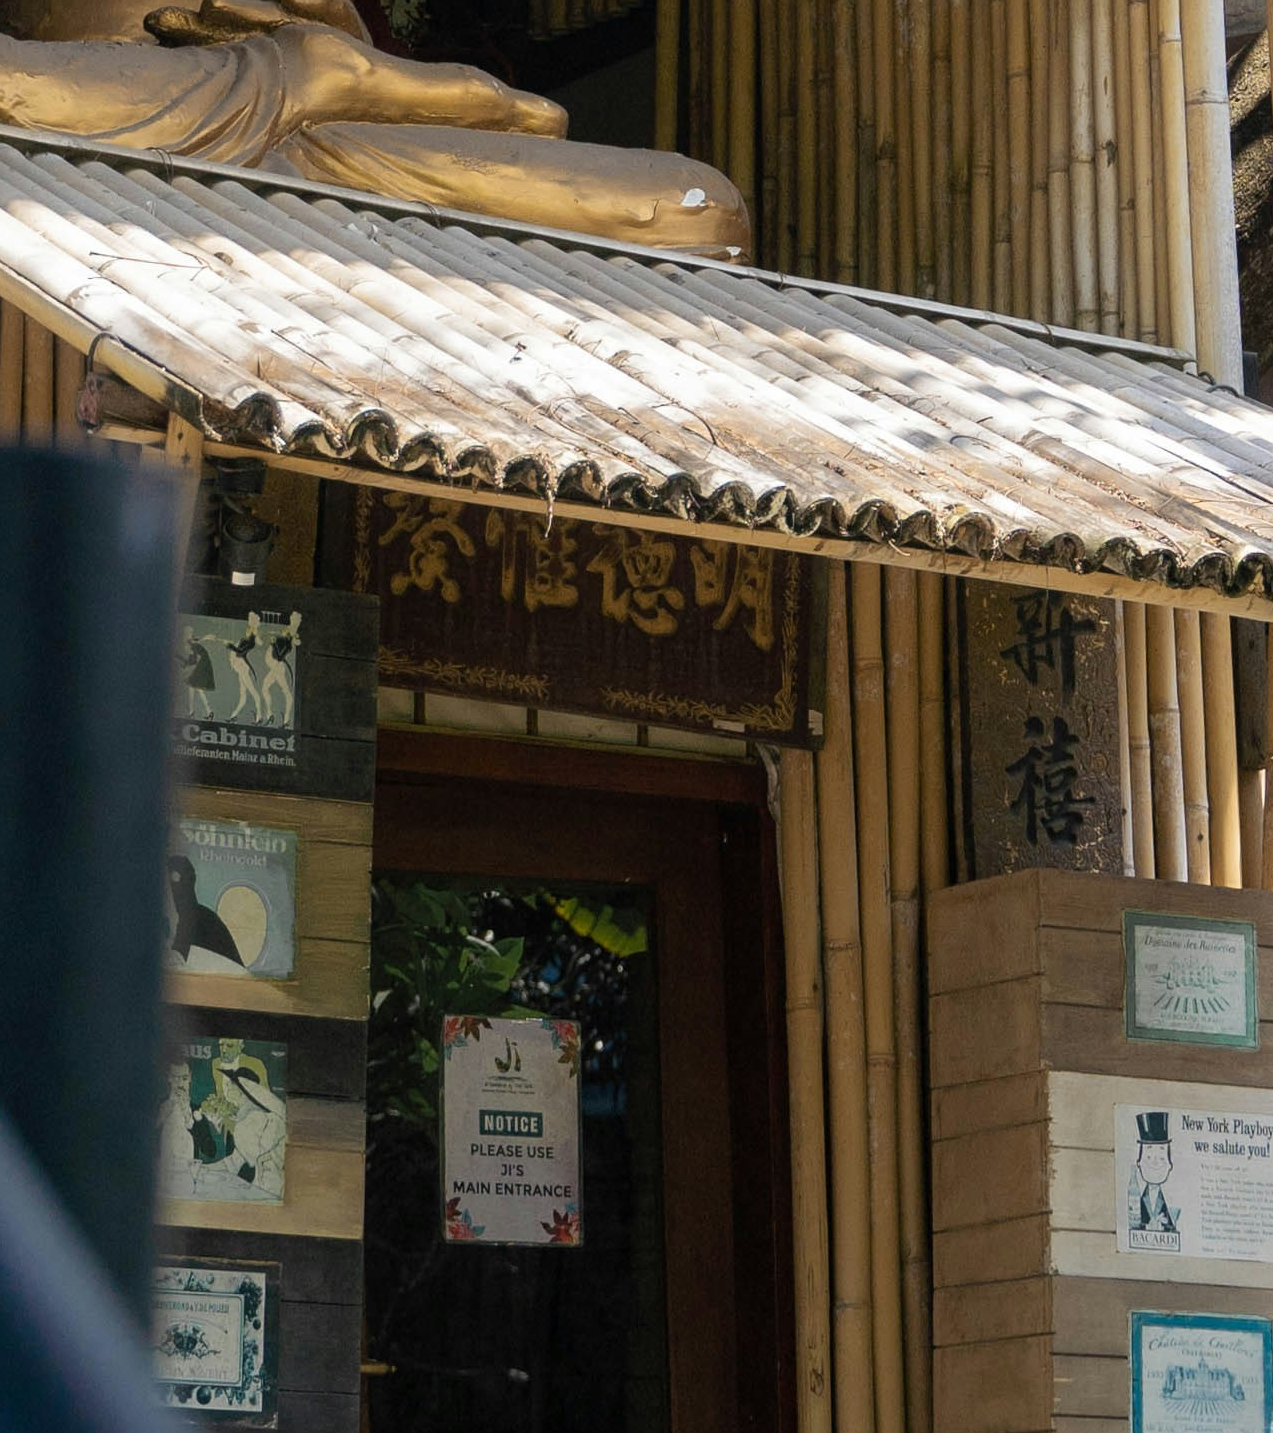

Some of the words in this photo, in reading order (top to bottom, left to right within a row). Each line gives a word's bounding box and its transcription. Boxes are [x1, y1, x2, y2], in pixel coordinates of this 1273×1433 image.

[182, 723, 296, 752] Cabinet
[484, 1114, 539, 1133] NOTICE
[1182, 1115, 1203, 1132] New
[1207, 1117, 1229, 1133] York
[470, 1143, 523, 1158] PLEASE
[527, 1146, 554, 1159] USE
[1194, 1141, 1209, 1152] we
[1213, 1140, 1245, 1155] salute
[1248, 1142, 1271, 1160] you!
[501, 1164, 524, 1177] JI'S
[453, 1181, 491, 1195] MAIN
[495, 1183, 572, 1198] ENTRANCE
[1131, 1232, 1178, 1246] BACARDI
